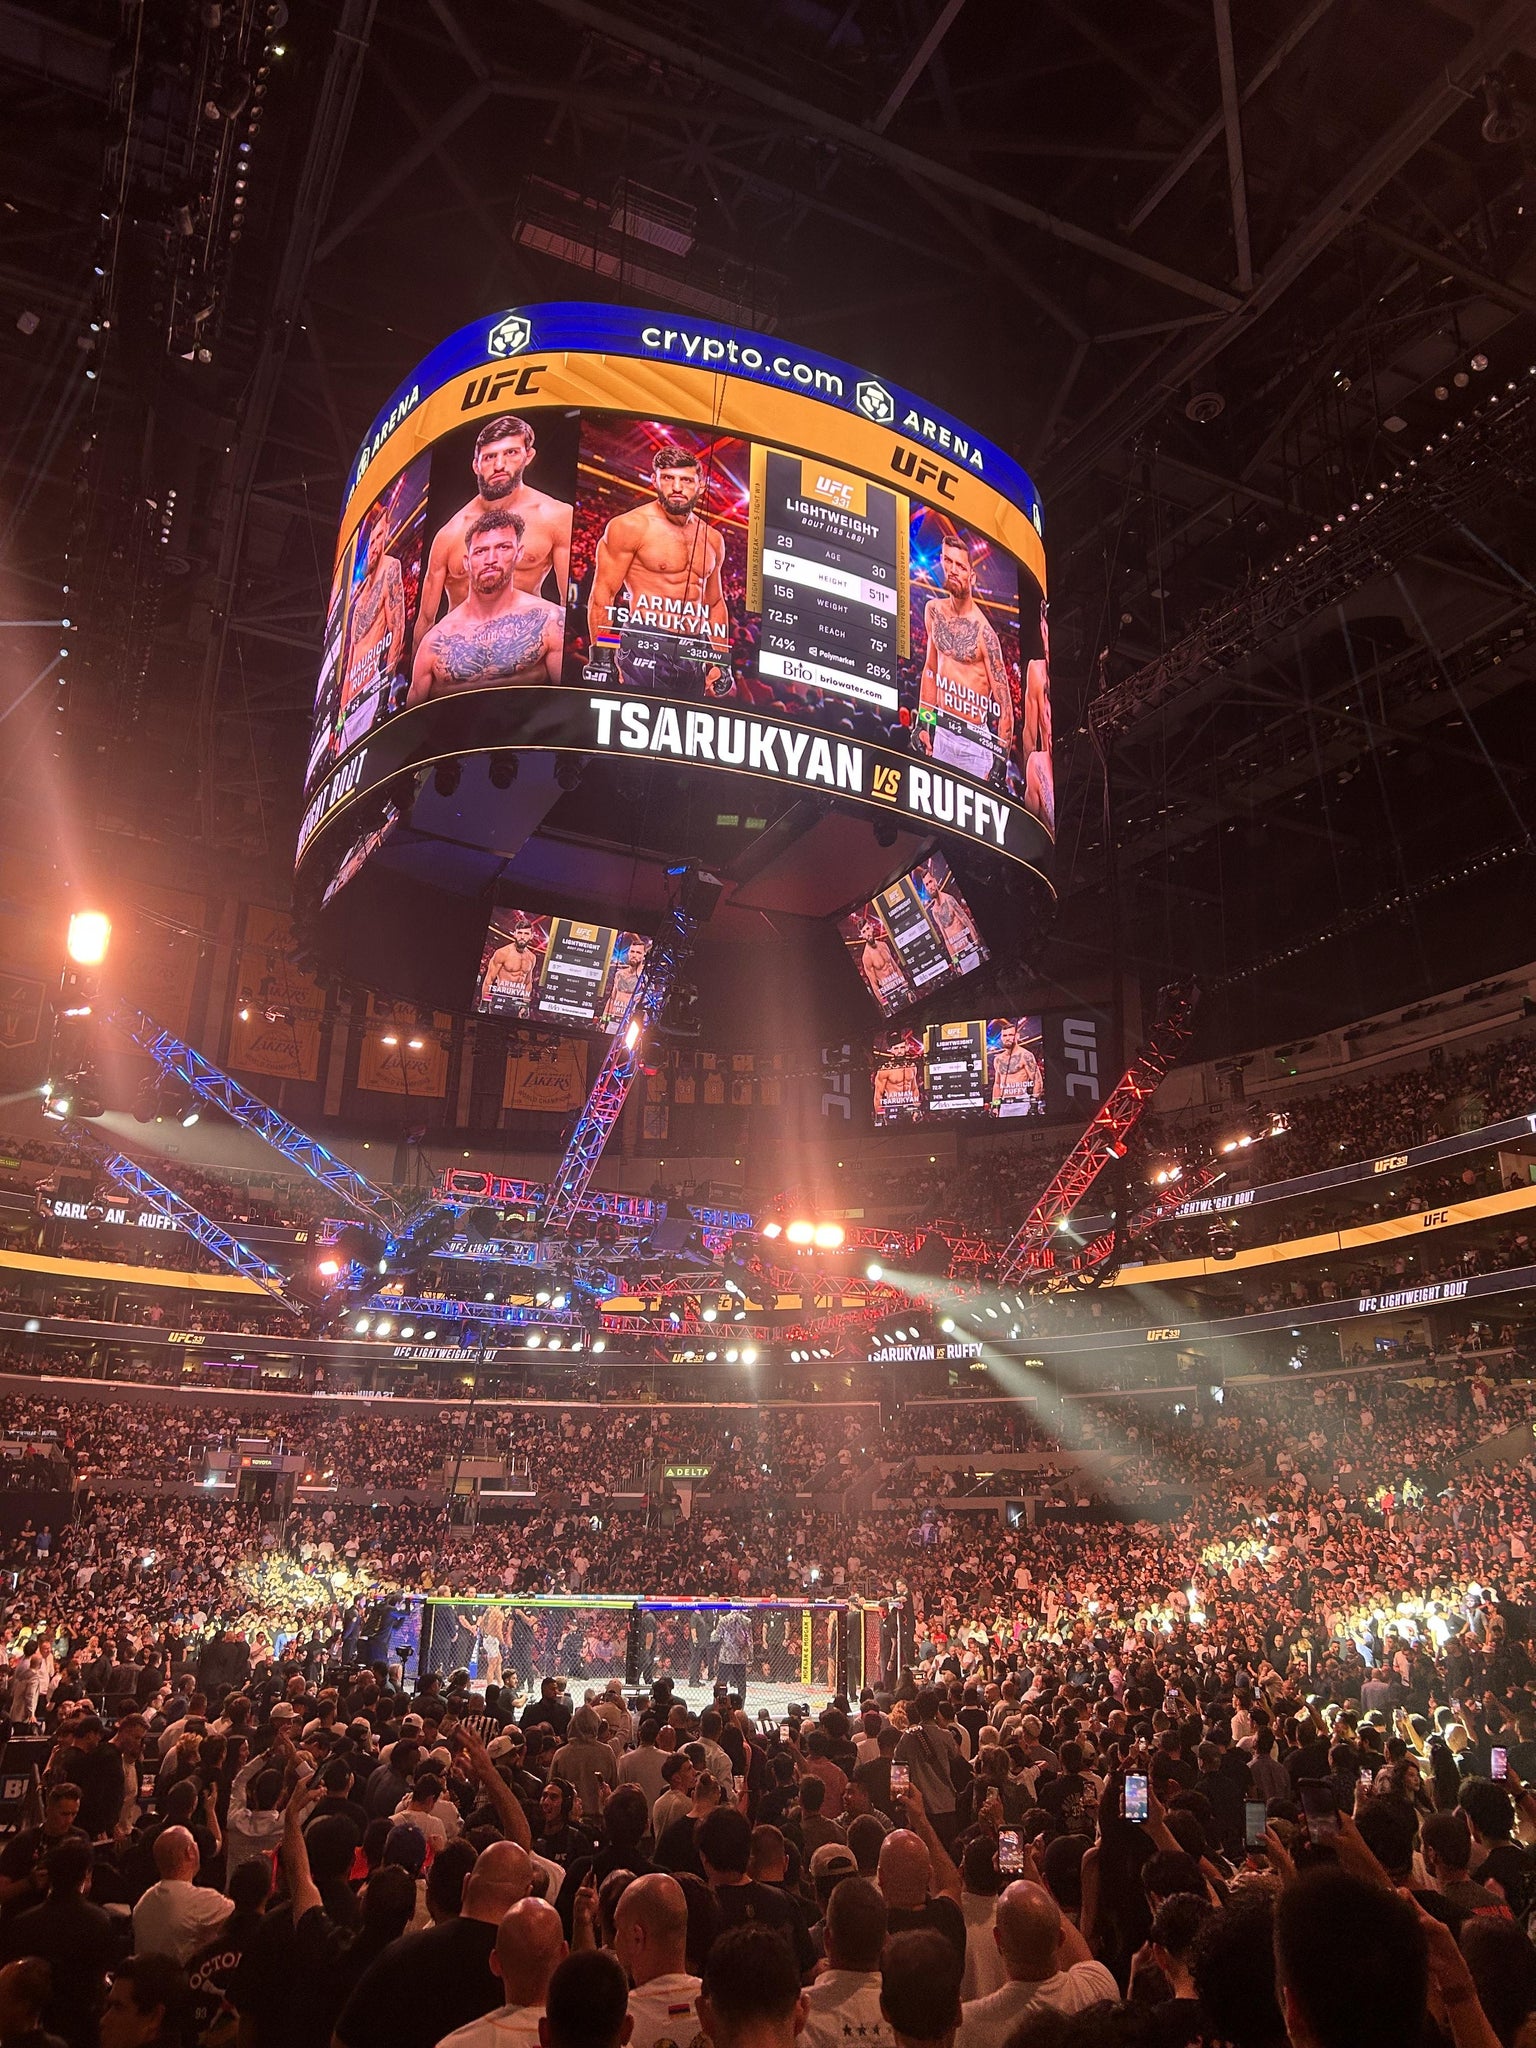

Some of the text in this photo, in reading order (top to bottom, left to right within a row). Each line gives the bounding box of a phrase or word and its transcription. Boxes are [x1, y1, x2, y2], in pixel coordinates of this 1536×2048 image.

[461, 366, 548, 411] UFC
[641, 326, 984, 470] crypto.com ARENA
[371, 385, 419, 458] ARENA
[890, 446, 959, 501] UFC
[815, 476, 854, 499] UFC
[832, 495, 850, 508] 331
[786, 498, 880, 539] LIGHTWEIGHT
[802, 518, 825, 530] BOUT
[777, 535, 793, 548] 29
[826, 551, 841, 562] AGE
[872, 565, 886, 578] 30
[818, 574, 848, 588] HEIGHT
[773, 584, 794, 599] 156
[636, 594, 710, 619] ARMAN
[816, 598, 849, 614] WEIGHT
[604, 606, 726, 638] TSARUKYAN
[768, 609, 798, 625] 72.5"
[870, 613, 888, 629] 155
[818, 624, 846, 638] REACH
[637, 640, 660, 651] 23-3
[769, 635, 796, 652] 74%
[870, 638, 888, 652] 75"
[350, 631, 393, 680] MAURICIO
[686, 649, 708, 659] -320
[819, 650, 856, 667] Polymarket
[633, 657, 656, 670] UFC
[866, 662, 891, 680] 26%
[352, 656, 381, 692] RUFFY
[783, 660, 883, 700] Brio briowater.com
[935, 674, 1001, 717] MAURICIO
[944, 693, 988, 724] RUFFY
[948, 721, 962, 734] 14-2
[328, 748, 368, 808] BOUT
[590, 698, 1011, 845] TSARUKYAN VS RUFFY
[576, 927, 592, 936] UFC
[562, 938, 600, 951] LIGHTWEIGHT
[488, 985, 531, 997] TSARUKYAN
[500, 980, 526, 990] ARMAN
[249, 1034, 304, 1058] LAKERS
[936, 1039, 974, 1047] LIGHTWEIGHT
[380, 1054, 431, 1075] LAKERS
[1063, 1018, 1100, 1101] UFC
[522, 1072, 570, 1091] LAKERS
[880, 1096, 919, 1105] TSARUKYAN
[1374, 1157, 1397, 1173] UFC
[1234, 1190, 1256, 1205] BOUT
[1423, 1211, 1449, 1227] UFC
[1358, 1281, 1468, 1312] UFC LIGHTWEIGHT BOUT
[168, 1332, 194, 1343] UFC
[1147, 1329, 1169, 1341] UFC
[393, 1346, 411, 1357] UFC
[413, 1348, 473, 1359] LIGHTWEIGHT
[936, 1347, 946, 1358] VS
[946, 1343, 984, 1358] RUFFY
[676, 1468, 709, 1476] DELTA
